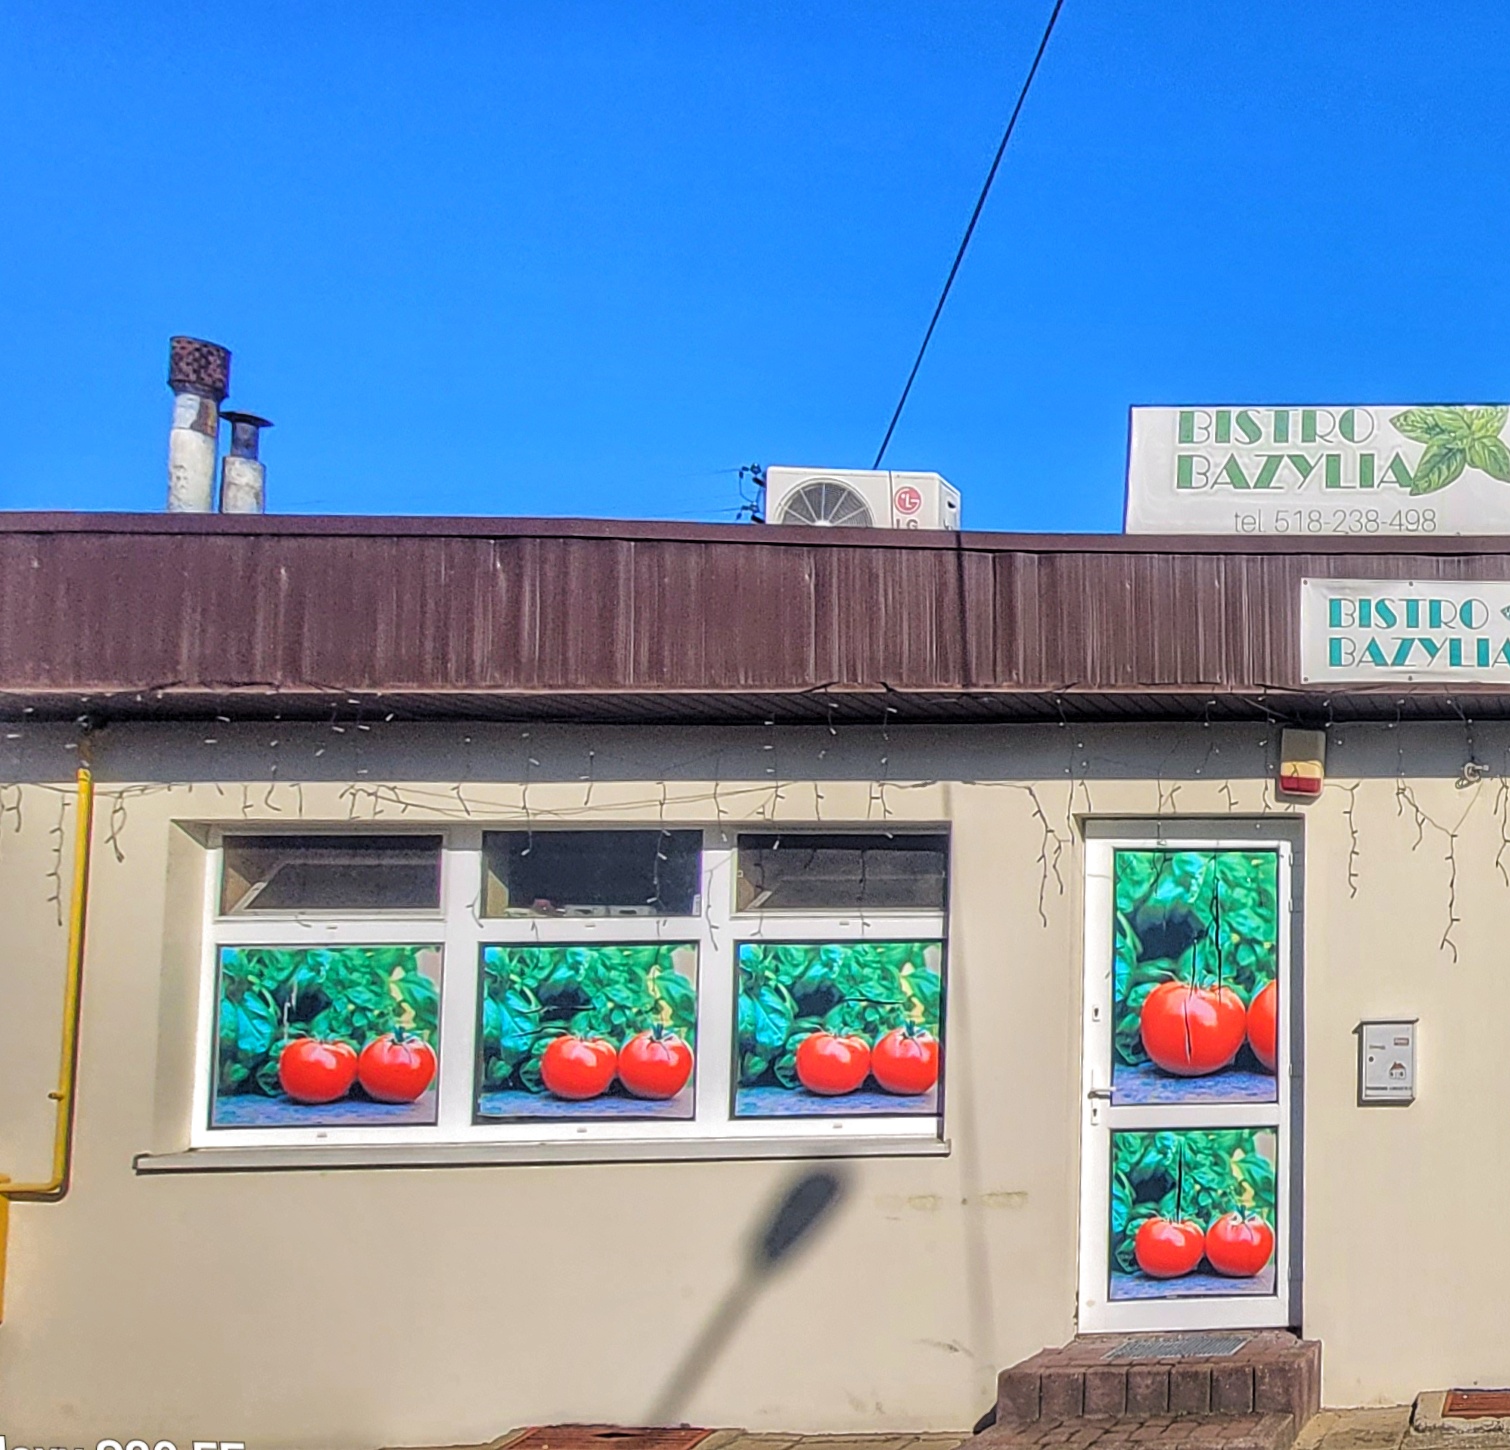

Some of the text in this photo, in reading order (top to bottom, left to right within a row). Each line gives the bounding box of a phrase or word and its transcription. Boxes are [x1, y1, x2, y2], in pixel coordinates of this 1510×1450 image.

[1178, 409, 1374, 445] BISTRO
[1177, 452, 1414, 489] BAZYLIA
[1274, 509, 1437, 533] 518-238-498
[1329, 598, 1489, 630] BISTRO
